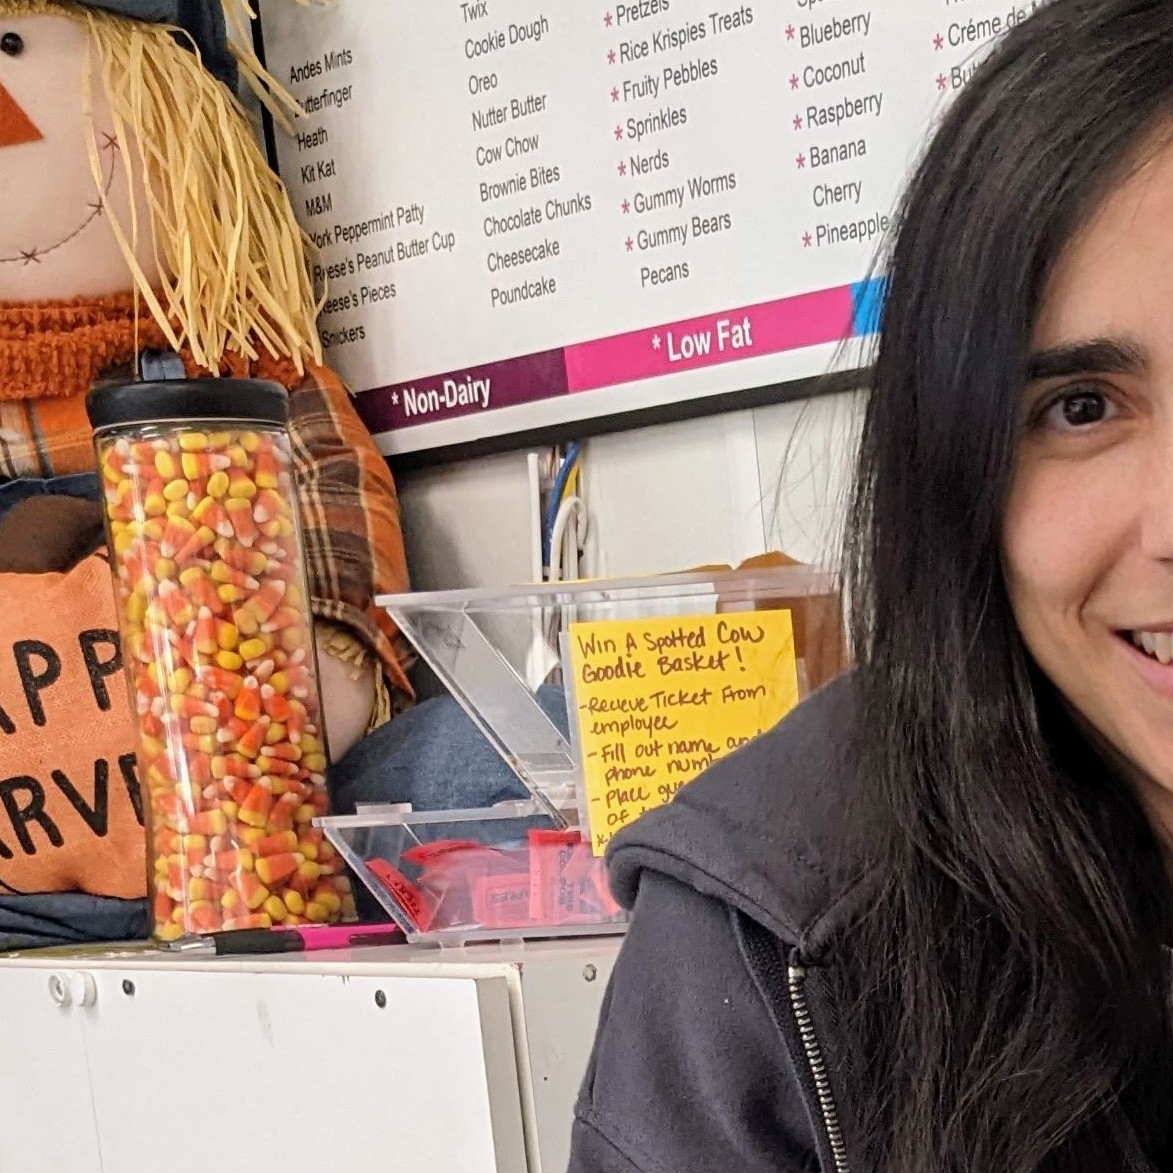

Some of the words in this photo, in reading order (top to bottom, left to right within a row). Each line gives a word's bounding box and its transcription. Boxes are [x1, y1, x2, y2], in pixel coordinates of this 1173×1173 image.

[460, 0, 488, 23] Twix
[616, 0, 670, 26] Pretzels
[1007, 6, 1027, 29] de
[465, 31, 506, 59] Cookie
[509, 15, 549, 45] Dough
[619, 40, 649, 64] Rice
[652, 22, 706, 53] Krispies
[709, 5, 754, 35] Treats
[800, 12, 871, 48] Blueberry
[290, 60, 322, 84] Andes
[324, 49, 353, 72] Mints
[623, 75, 660, 102] Fruity
[663, 58, 718, 90] Pebbles
[803, 52, 866, 88] Coconut
[468, 73, 498, 95] Oreo
[294, 85, 353, 118] utterfinger
[472, 106, 508, 132] Nutter
[511, 94, 547, 119] Butter
[806, 92, 883, 129] Raspberry
[297, 127, 329, 152] Heath
[626, 106, 687, 142] Sprinkles
[476, 145, 502, 167] Cow
[505, 134, 539, 158] Chow
[630, 149, 670, 177] Nerds
[809, 139, 867, 168] Banana
[301, 164, 316, 183] Kit
[317, 158, 336, 179] Kat
[479, 173, 527, 202] Brownie
[530, 166, 560, 188] Bites
[305, 193, 333, 217] M&M
[634, 186, 685, 214] Gummy
[688, 173, 736, 200] Worms
[813, 180, 862, 208] Cherry
[334, 210, 395, 244] Peppermint
[397, 204, 424, 227] Patty
[483, 208, 542, 237] Chocolate
[545, 192, 592, 220] Chunks
[816, 212, 890, 247] Pineapple
[637, 223, 688, 251] Gummy
[691, 212, 732, 238] Bears
[356, 243, 395, 272] Peanut
[397, 237, 429, 261] Butter
[432, 231, 455, 252] Cup
[487, 238, 560, 272] Cheesecake
[641, 262, 690, 288] Pecans
[360, 283, 397, 305] Pieces
[491, 276, 556, 308] Poundcake
[667, 330, 712, 362] Low
[717, 316, 753, 352] Fat
[403, 375, 491, 418] Non-Dairy
[578, 632, 617, 659] Win
[625, 632, 638, 651] A
[643, 626, 706, 655] Spotted
[717, 621, 765, 644] Cow
[582, 655, 646, 684] Goodie
[722, 684, 766, 704] From
[590, 714, 678, 738] employee
[635, 740, 663, 759] out
[668, 739, 720, 755] name
[727, 728, 761, 749] an
[605, 766, 656, 787] phone
